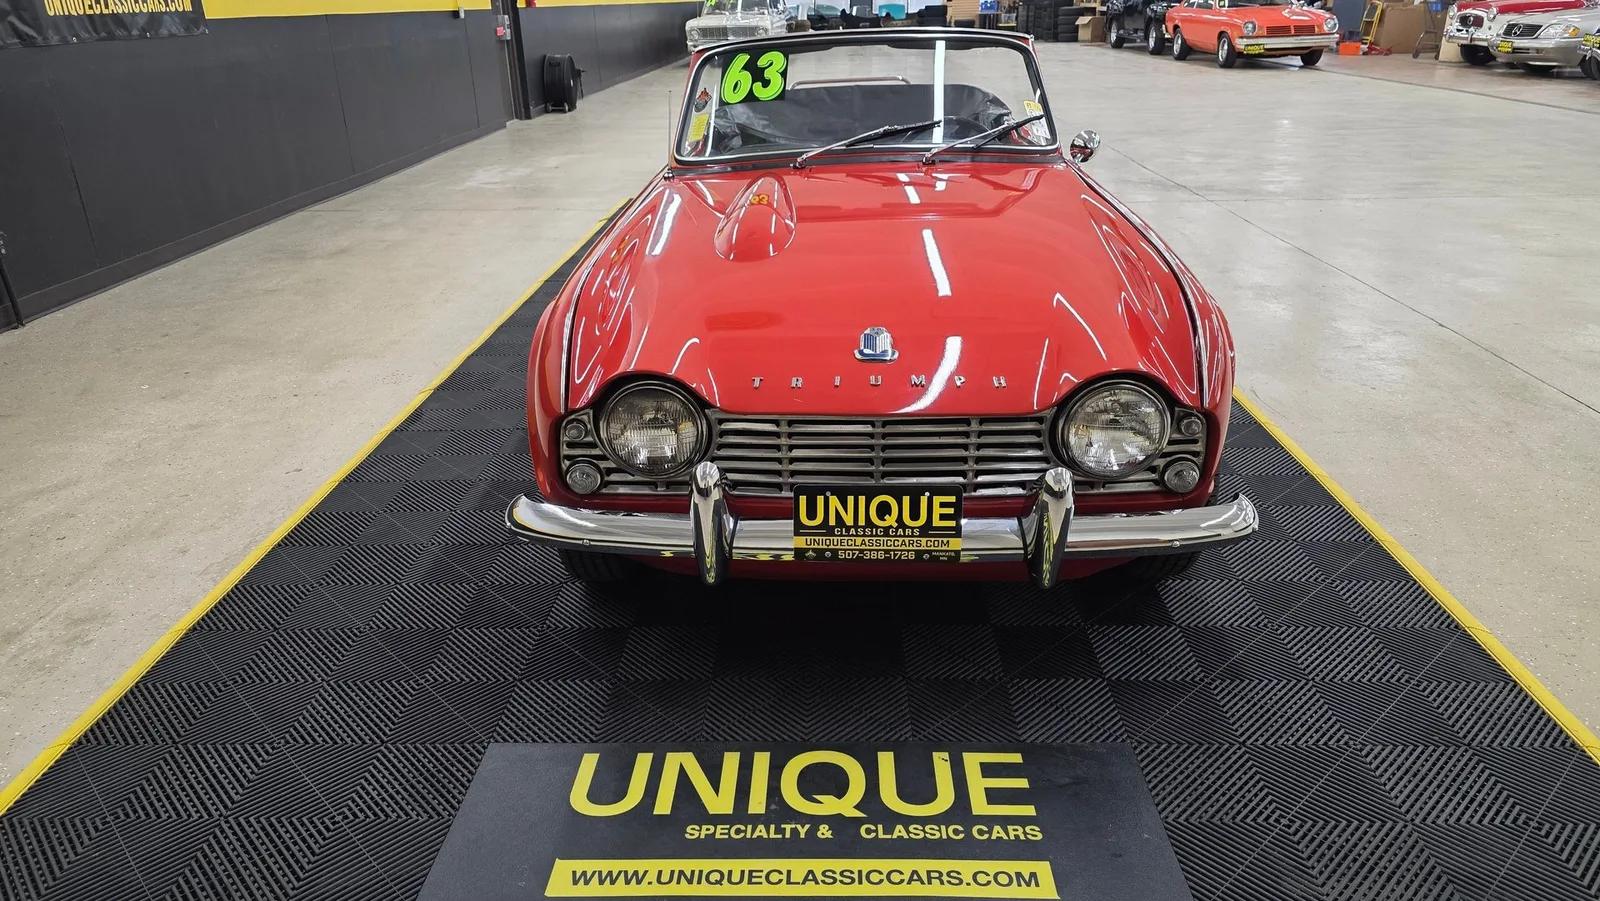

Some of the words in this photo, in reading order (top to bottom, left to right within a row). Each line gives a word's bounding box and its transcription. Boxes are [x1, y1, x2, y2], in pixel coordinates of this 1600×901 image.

[721, 51, 787, 104] 63
[752, 374, 1007, 389] TRIUMPH
[799, 495, 957, 528] UNIQUE
[834, 527, 884, 536] CLASSIC
[889, 527, 920, 536] CARS
[805, 537, 950, 549] UNIQUECLASSICCARS.COM
[838, 550, 915, 560] 507-386-1726
[569, 751, 1037, 818] UNIQUE
[684, 823, 809, 840] SPECIALTY
[817, 824, 833, 839] &
[860, 823, 965, 840] CLASSIC
[972, 824, 1043, 841] CARS
[571, 868, 1040, 888] WWW.UNIQUECLASSICCARS.COM
